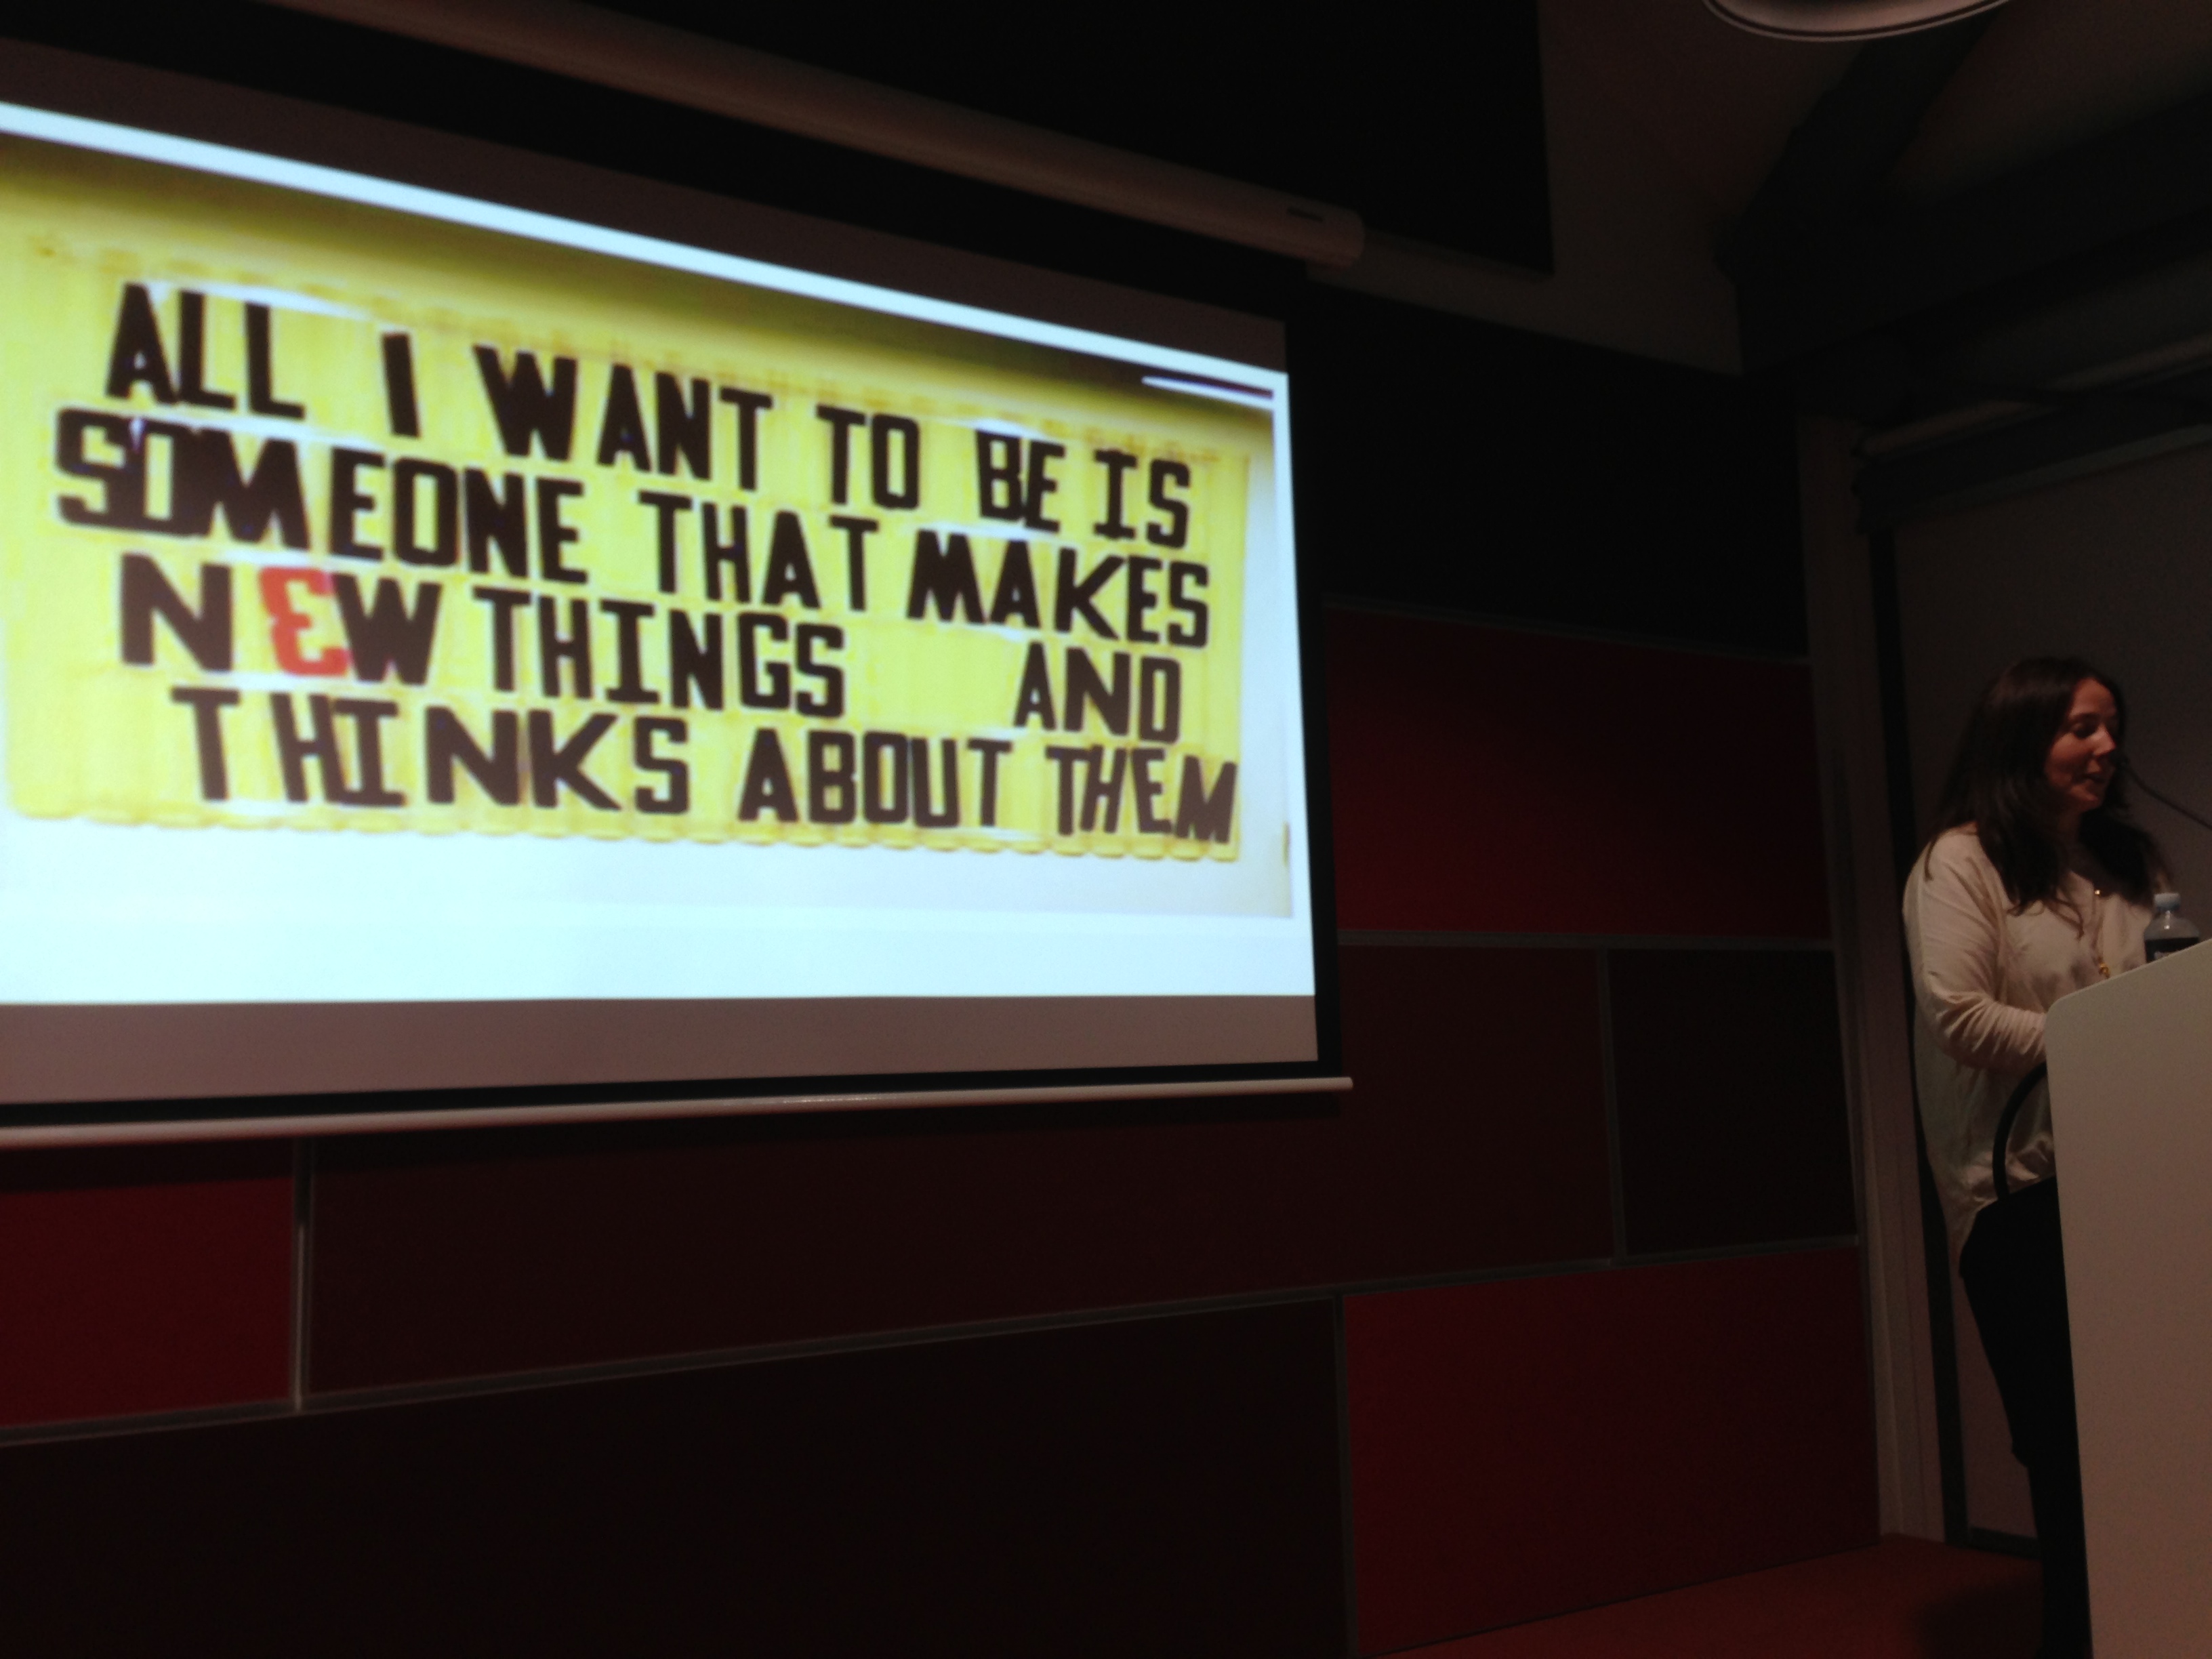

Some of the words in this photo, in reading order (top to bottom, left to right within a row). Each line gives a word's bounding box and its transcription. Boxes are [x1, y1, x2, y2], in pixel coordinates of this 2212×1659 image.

[105, 283, 306, 420] ALL
[382, 332, 420, 438] I
[473, 344, 773, 492] WANT
[817, 404, 920, 510] TO
[975, 428, 1065, 534] BE
[1094, 449, 1190, 549] IS
[56, 408, 588, 584] SOMEONE
[638, 491, 878, 613] THAT
[907, 529, 1208, 649] MAKES
[121, 554, 442, 686] NEW
[473, 587, 846, 719] THINGS
[1013, 641, 1181, 744] AND
[171, 687, 690, 815] THINKS
[739, 728, 1012, 828] ABOUT
[1046, 745, 1237, 844] THEM
